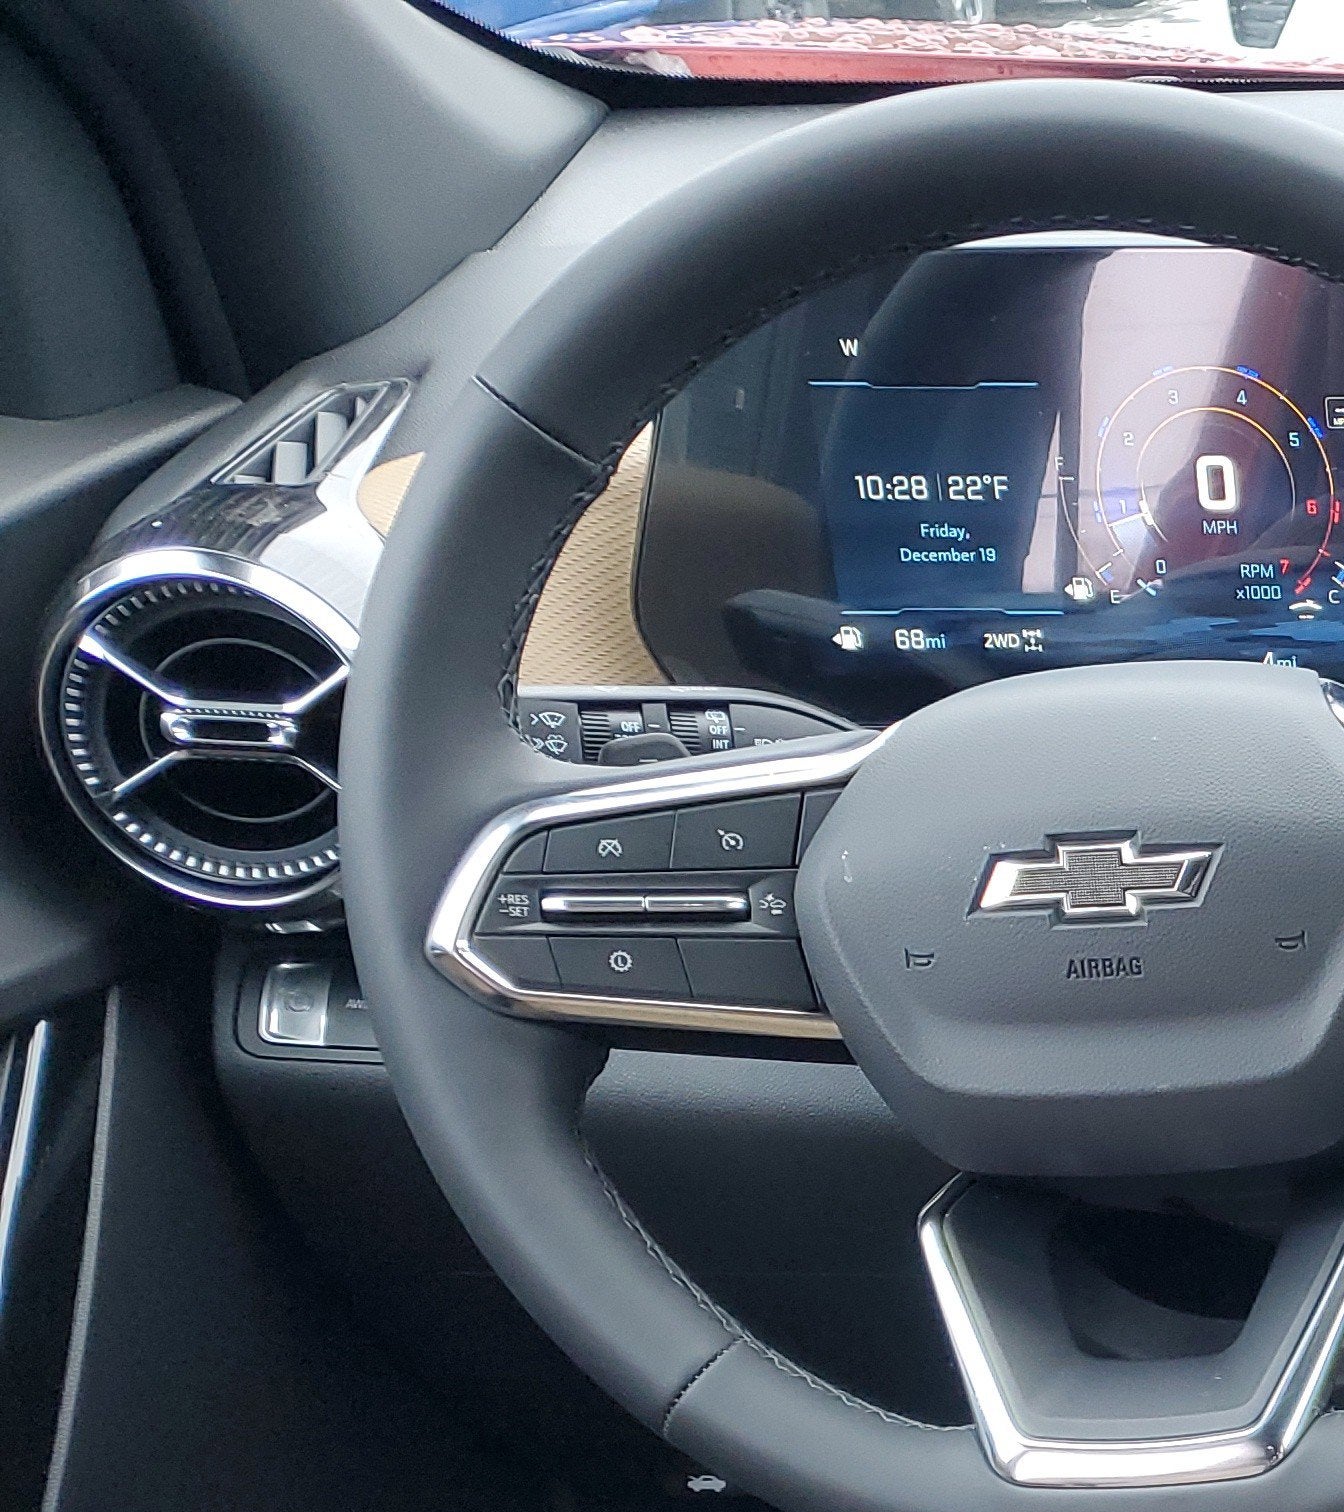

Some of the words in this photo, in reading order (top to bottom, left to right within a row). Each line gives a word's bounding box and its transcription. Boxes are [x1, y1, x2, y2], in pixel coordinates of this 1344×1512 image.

[839, 338, 859, 356] W
[1168, 390, 1179, 405] 3
[1236, 390, 1247, 405] 4
[1123, 433, 1135, 446] 2
[1289, 433, 1300, 447] 5
[854, 475, 929, 500] 10:28
[947, 474, 1009, 501] 22°F
[1195, 455, 1239, 511] 0
[1306, 500, 1318, 515] 6
[920, 523, 971, 542] Friday,
[1202, 520, 1239, 535] MPH
[900, 547, 976, 563] December
[979, 548, 996, 563] 19
[1240, 564, 1274, 579] RPM
[1280, 559, 1290, 574] 7
[1110, 590, 1120, 603] E
[1235, 585, 1281, 600] x1000
[1328, 589, 1340, 604] C
[983, 633, 1020, 648] 2WD
[620, 721, 641, 733] OFF
[709, 725, 728, 735] OFF
[711, 738, 730, 750] INT
[1066, 957, 1142, 980] AIRBAG
